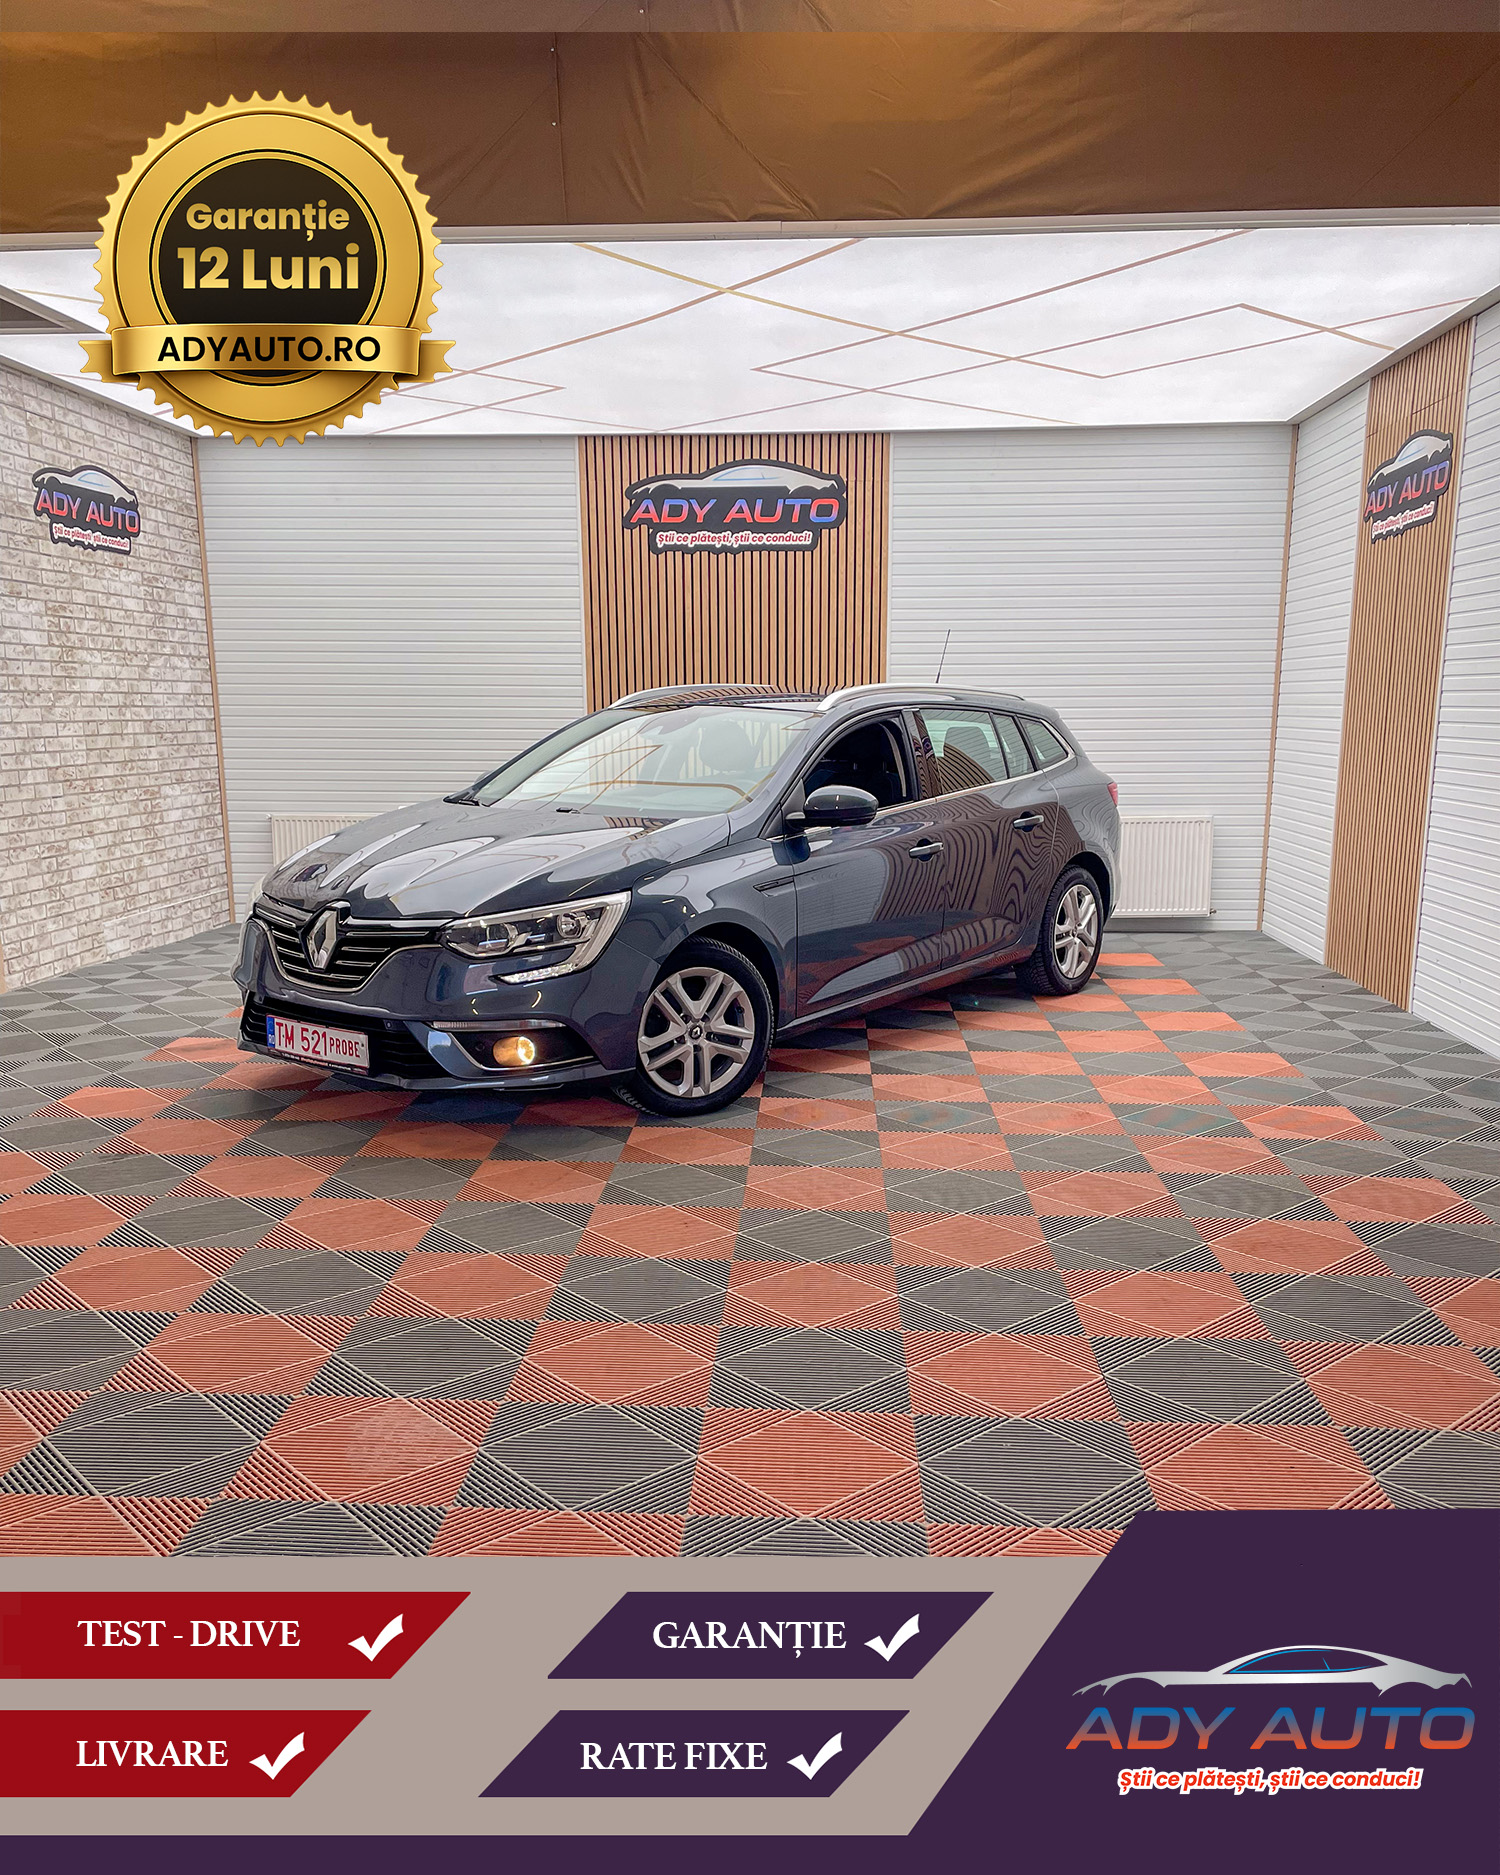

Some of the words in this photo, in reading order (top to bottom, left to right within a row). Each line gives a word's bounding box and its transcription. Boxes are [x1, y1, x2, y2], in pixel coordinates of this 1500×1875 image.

[1364, 481, 1399, 517] ADY
[1399, 460, 1450, 505] AUTO
[36, 488, 81, 519] ADY
[85, 501, 139, 532] AUTO
[630, 498, 717, 523] ADY
[723, 498, 840, 523] AUTO
[658, 532, 674, 545] Știi
[676, 535, 688, 543] ce
[690, 532, 732, 546] plătești,
[734, 532, 750, 545] știi
[751, 535, 763, 543] ce
[765, 532, 811, 543] conduci!
[275, 1021, 295, 1050] TM
[300, 1026, 328, 1057] 521
[329, 1036, 360, 1058] PROBE
